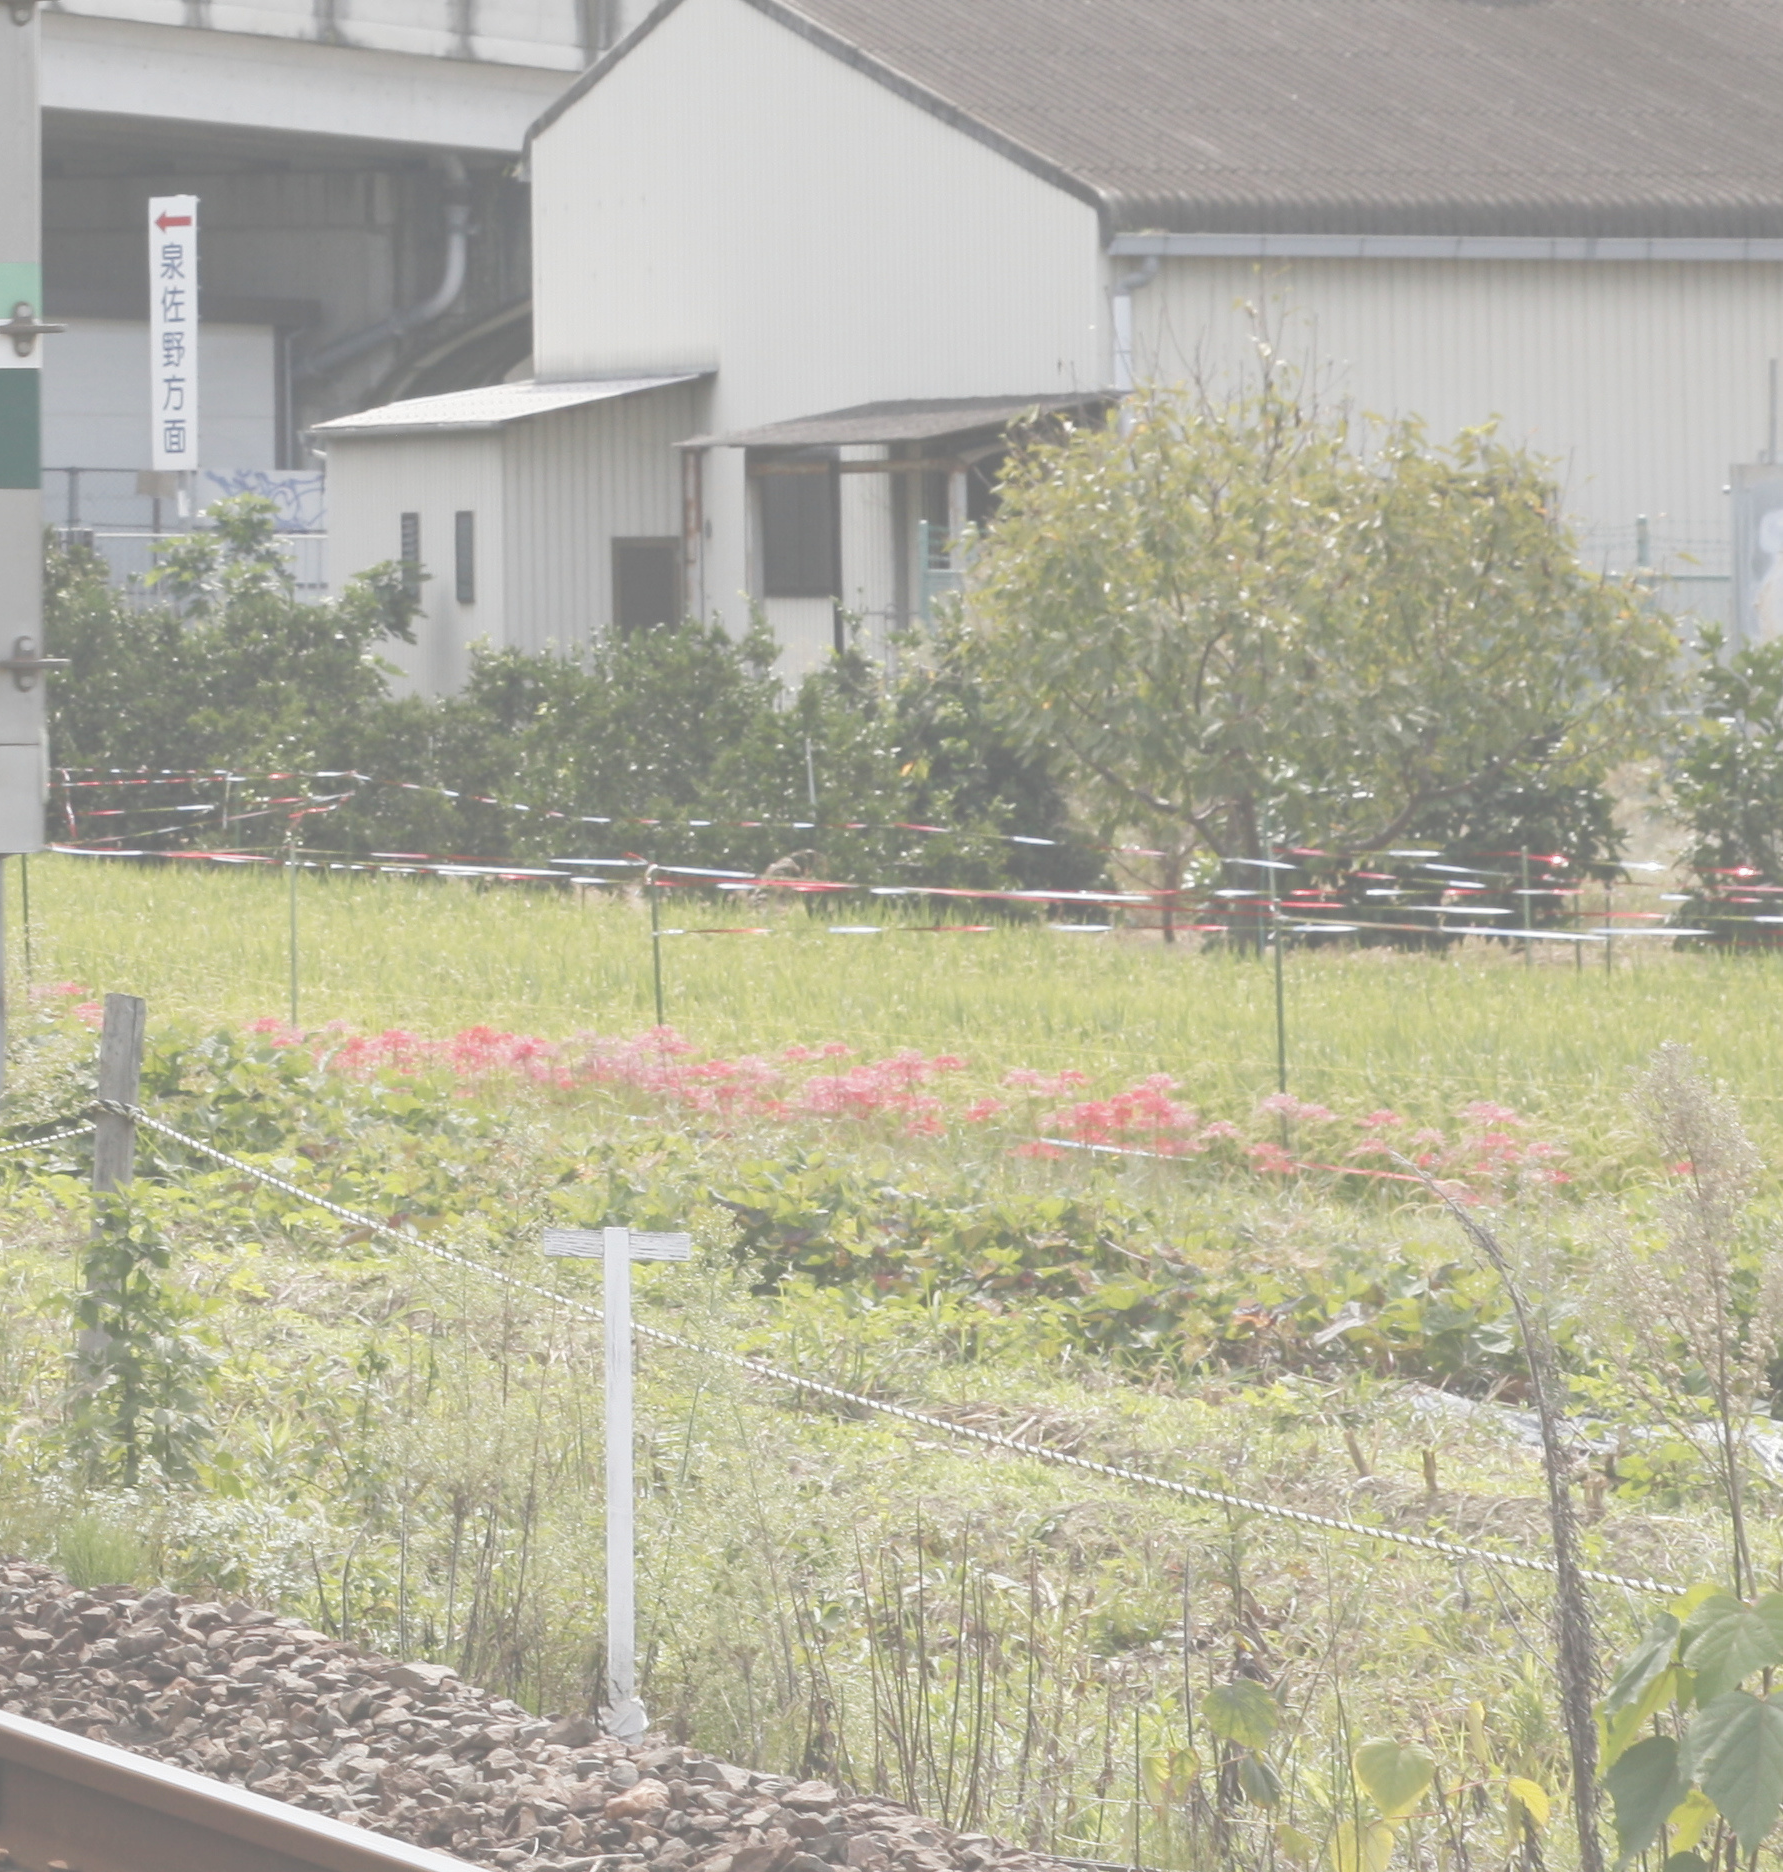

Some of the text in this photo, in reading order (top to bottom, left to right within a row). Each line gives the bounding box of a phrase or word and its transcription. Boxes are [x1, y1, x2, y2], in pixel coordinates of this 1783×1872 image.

[161, 242, 186, 453] 泉佐野方面
